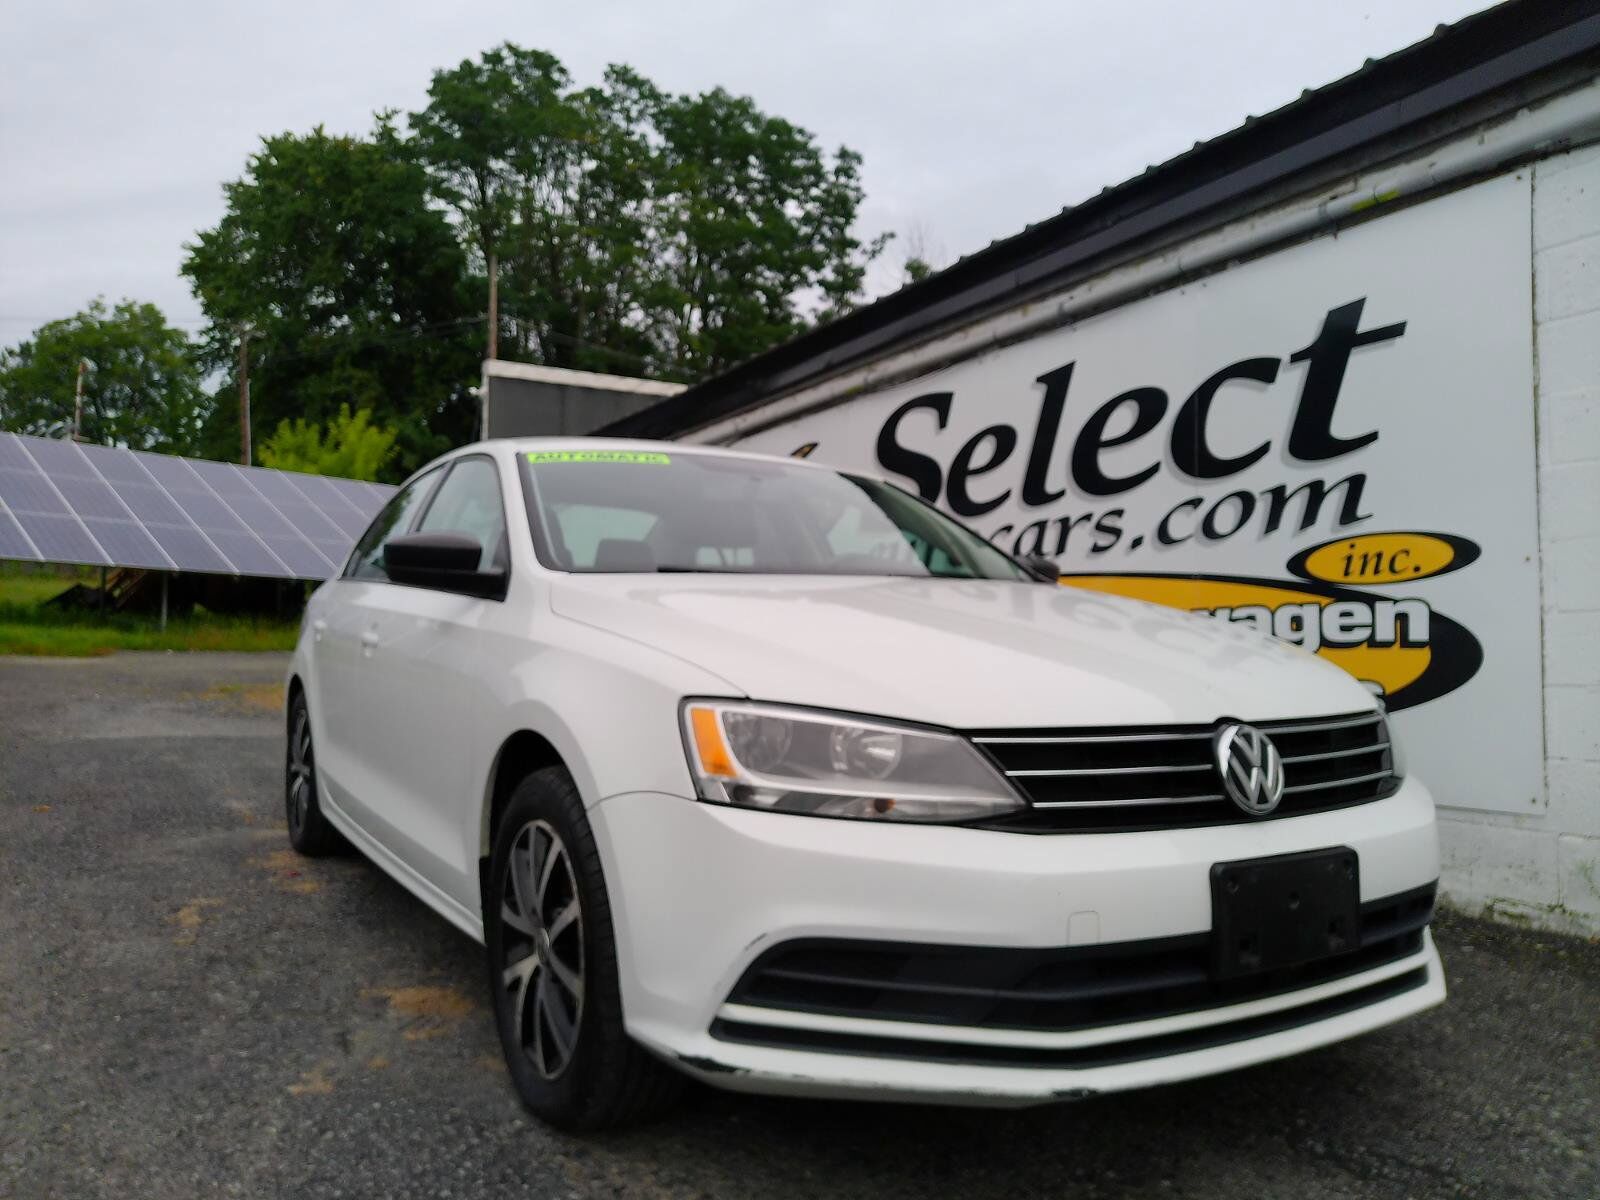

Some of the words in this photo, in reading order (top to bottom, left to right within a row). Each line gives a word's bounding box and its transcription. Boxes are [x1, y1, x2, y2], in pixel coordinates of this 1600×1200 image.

[876, 297, 1407, 517] Select
[530, 452, 669, 464] AUTOMATIC
[1342, 543, 1422, 577] inc.
